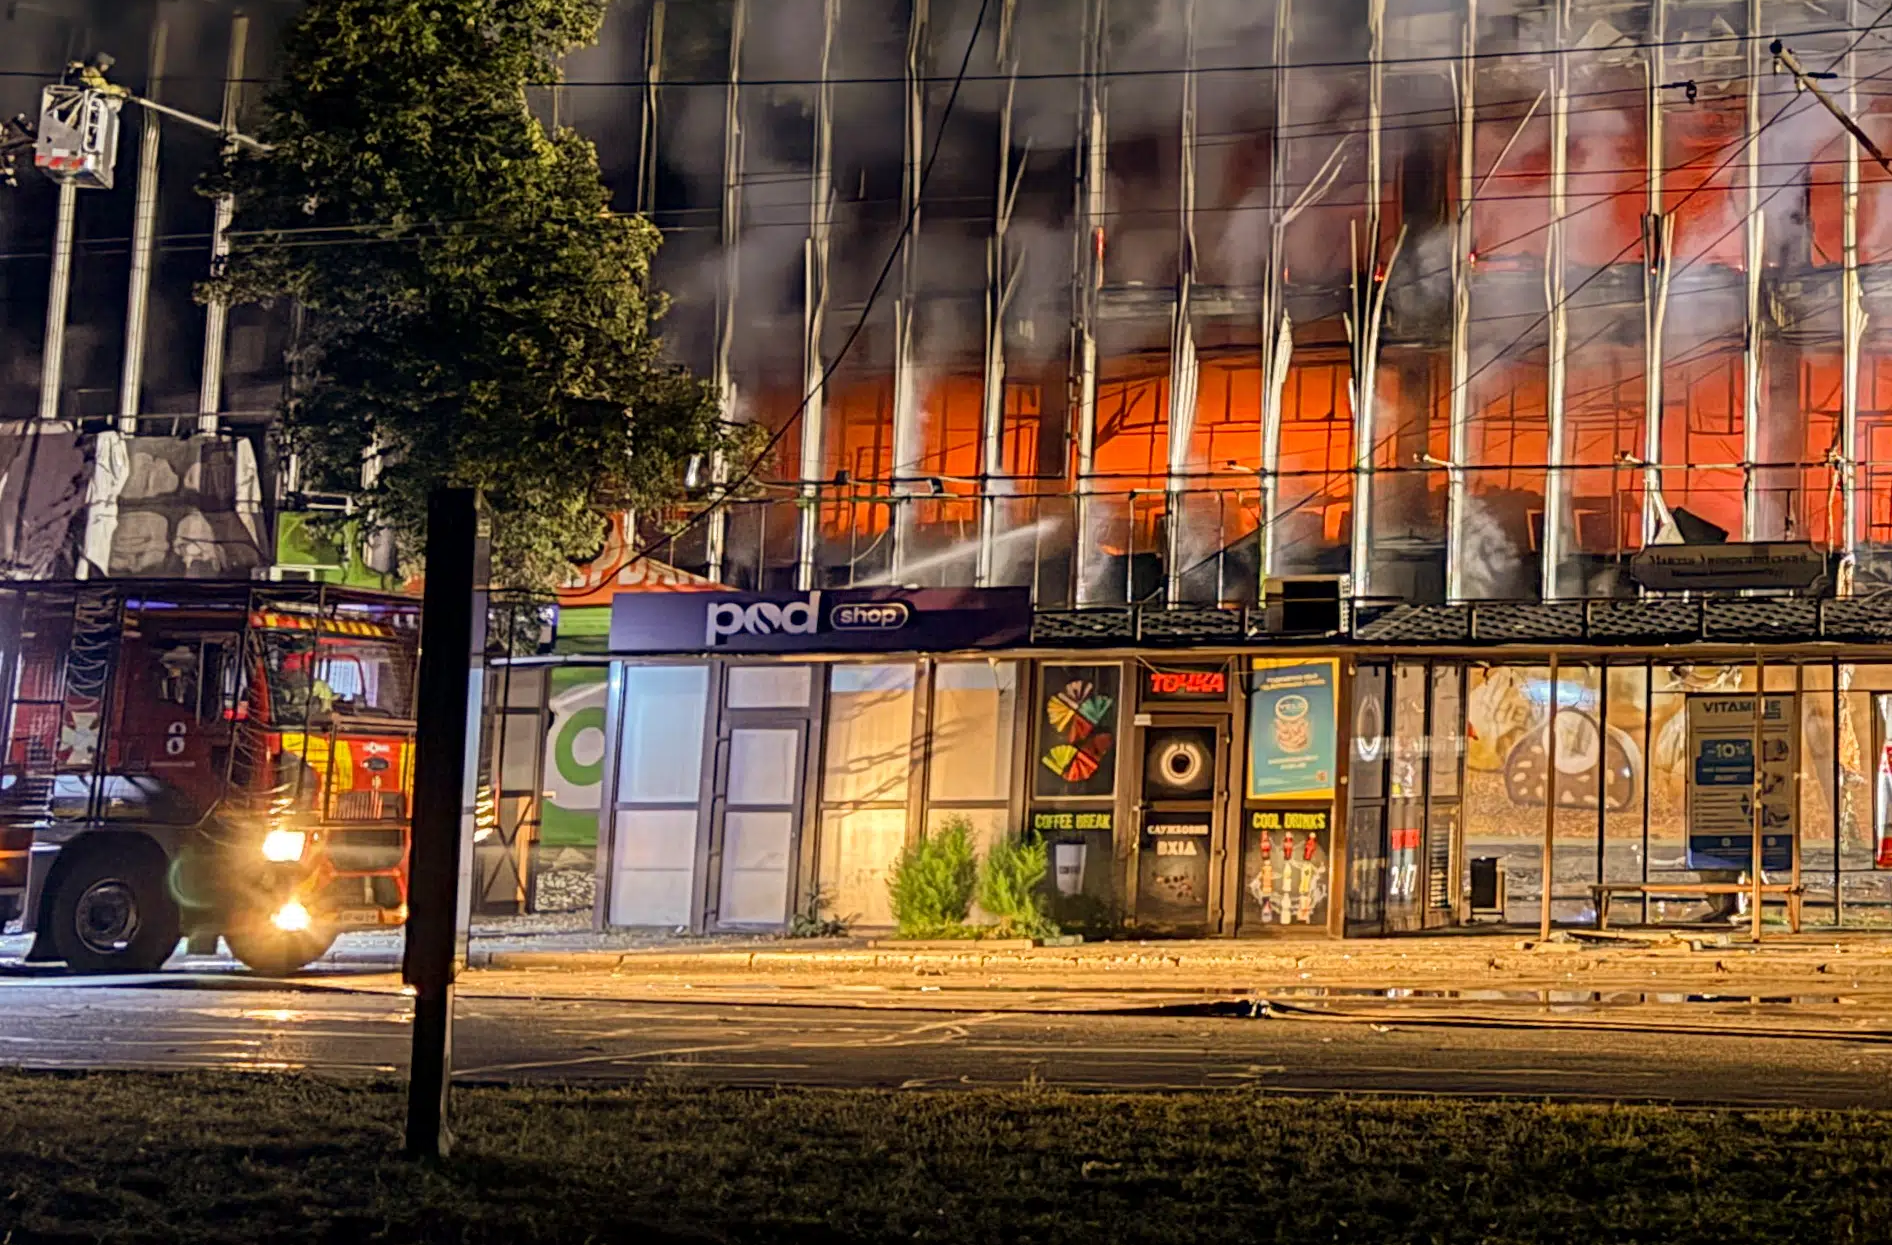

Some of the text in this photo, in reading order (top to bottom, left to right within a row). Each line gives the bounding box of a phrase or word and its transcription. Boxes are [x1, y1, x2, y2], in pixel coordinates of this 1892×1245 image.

[705, 590, 897, 646] pod shop
[1150, 672, 1225, 693] ТОЧКА
[1702, 700, 1781, 713] VITAME
[1035, 813, 1073, 829] COFFEE
[1252, 812, 1282, 829] COOL
